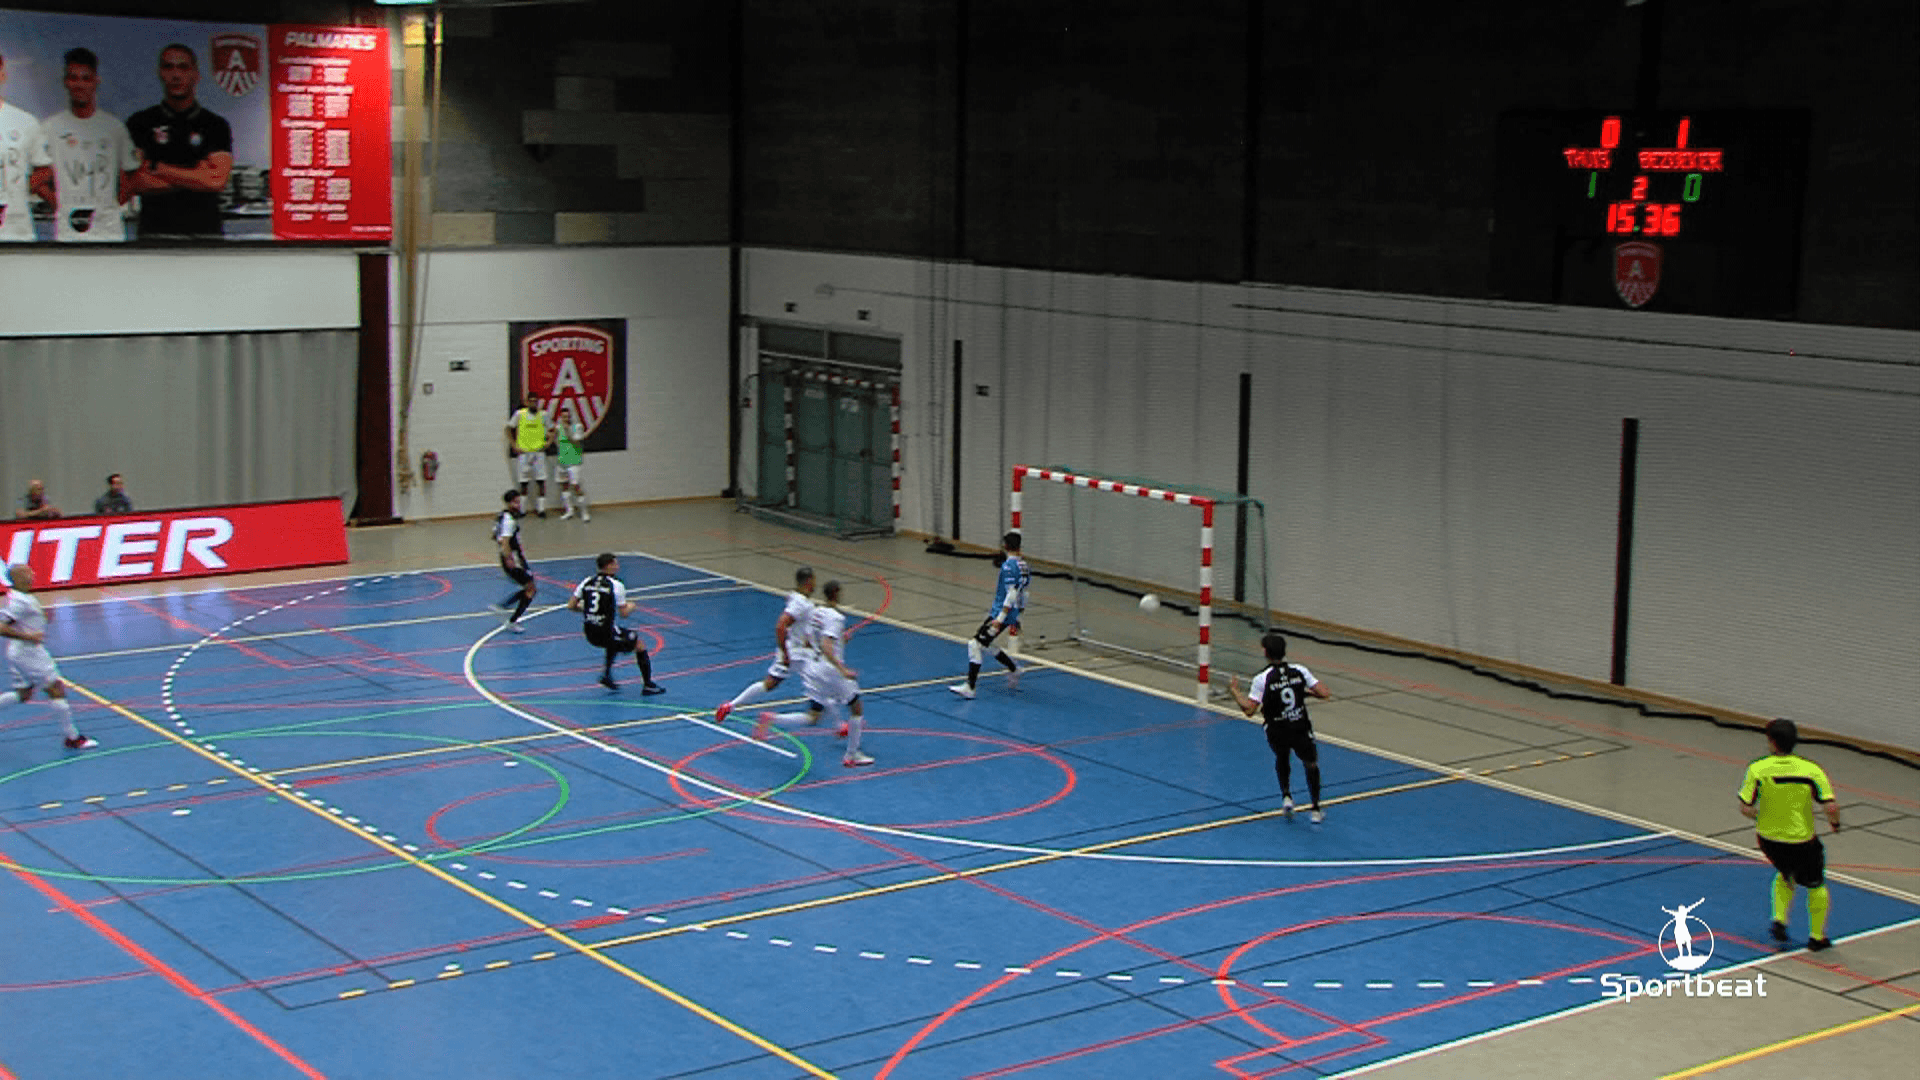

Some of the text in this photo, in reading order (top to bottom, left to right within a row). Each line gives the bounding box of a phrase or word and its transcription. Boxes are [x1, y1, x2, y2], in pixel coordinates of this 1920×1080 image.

[285, 32, 376, 50] PALMARES
[1601, 117, 1621, 149] 0
[1677, 117, 1690, 148] 1
[1588, 172, 1597, 197] 1
[1632, 176, 1648, 201] 2
[1684, 173, 1702, 202] 0
[531, 337, 604, 357] SPORTING
[552, 357, 585, 396] A
[588, 591, 601, 613] 3
[1280, 688, 1296, 711] 9
